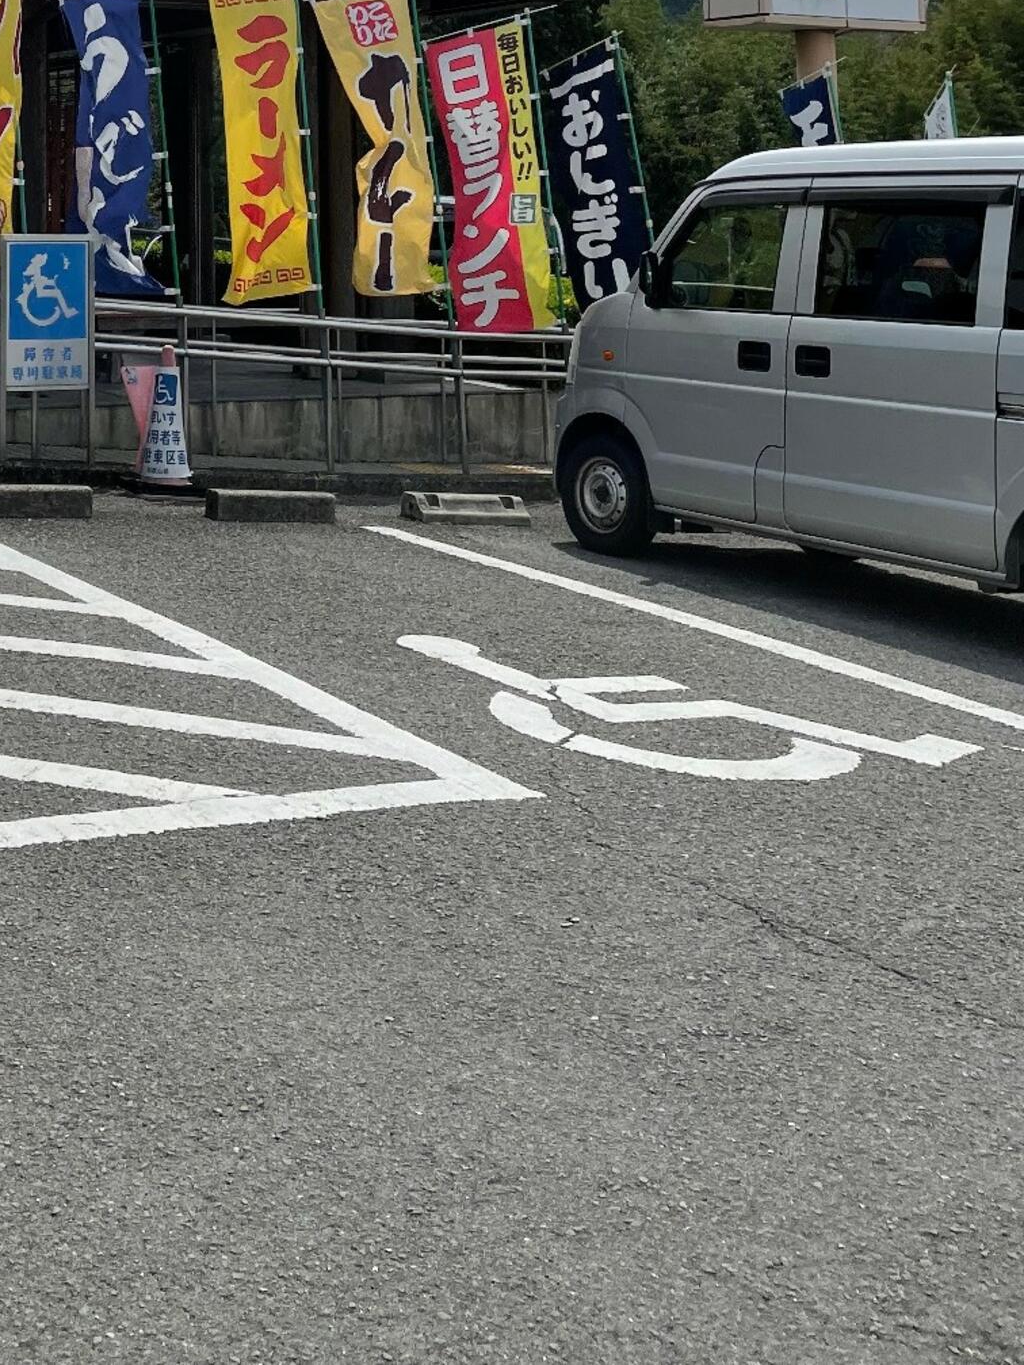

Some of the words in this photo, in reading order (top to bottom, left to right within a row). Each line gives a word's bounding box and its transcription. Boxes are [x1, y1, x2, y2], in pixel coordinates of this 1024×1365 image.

[235, 15, 294, 263] ラーメン
[358, 53, 414, 291] カレー
[437, 43, 520, 328] 日替ランチ
[148, 430, 181, 446] 用者等
